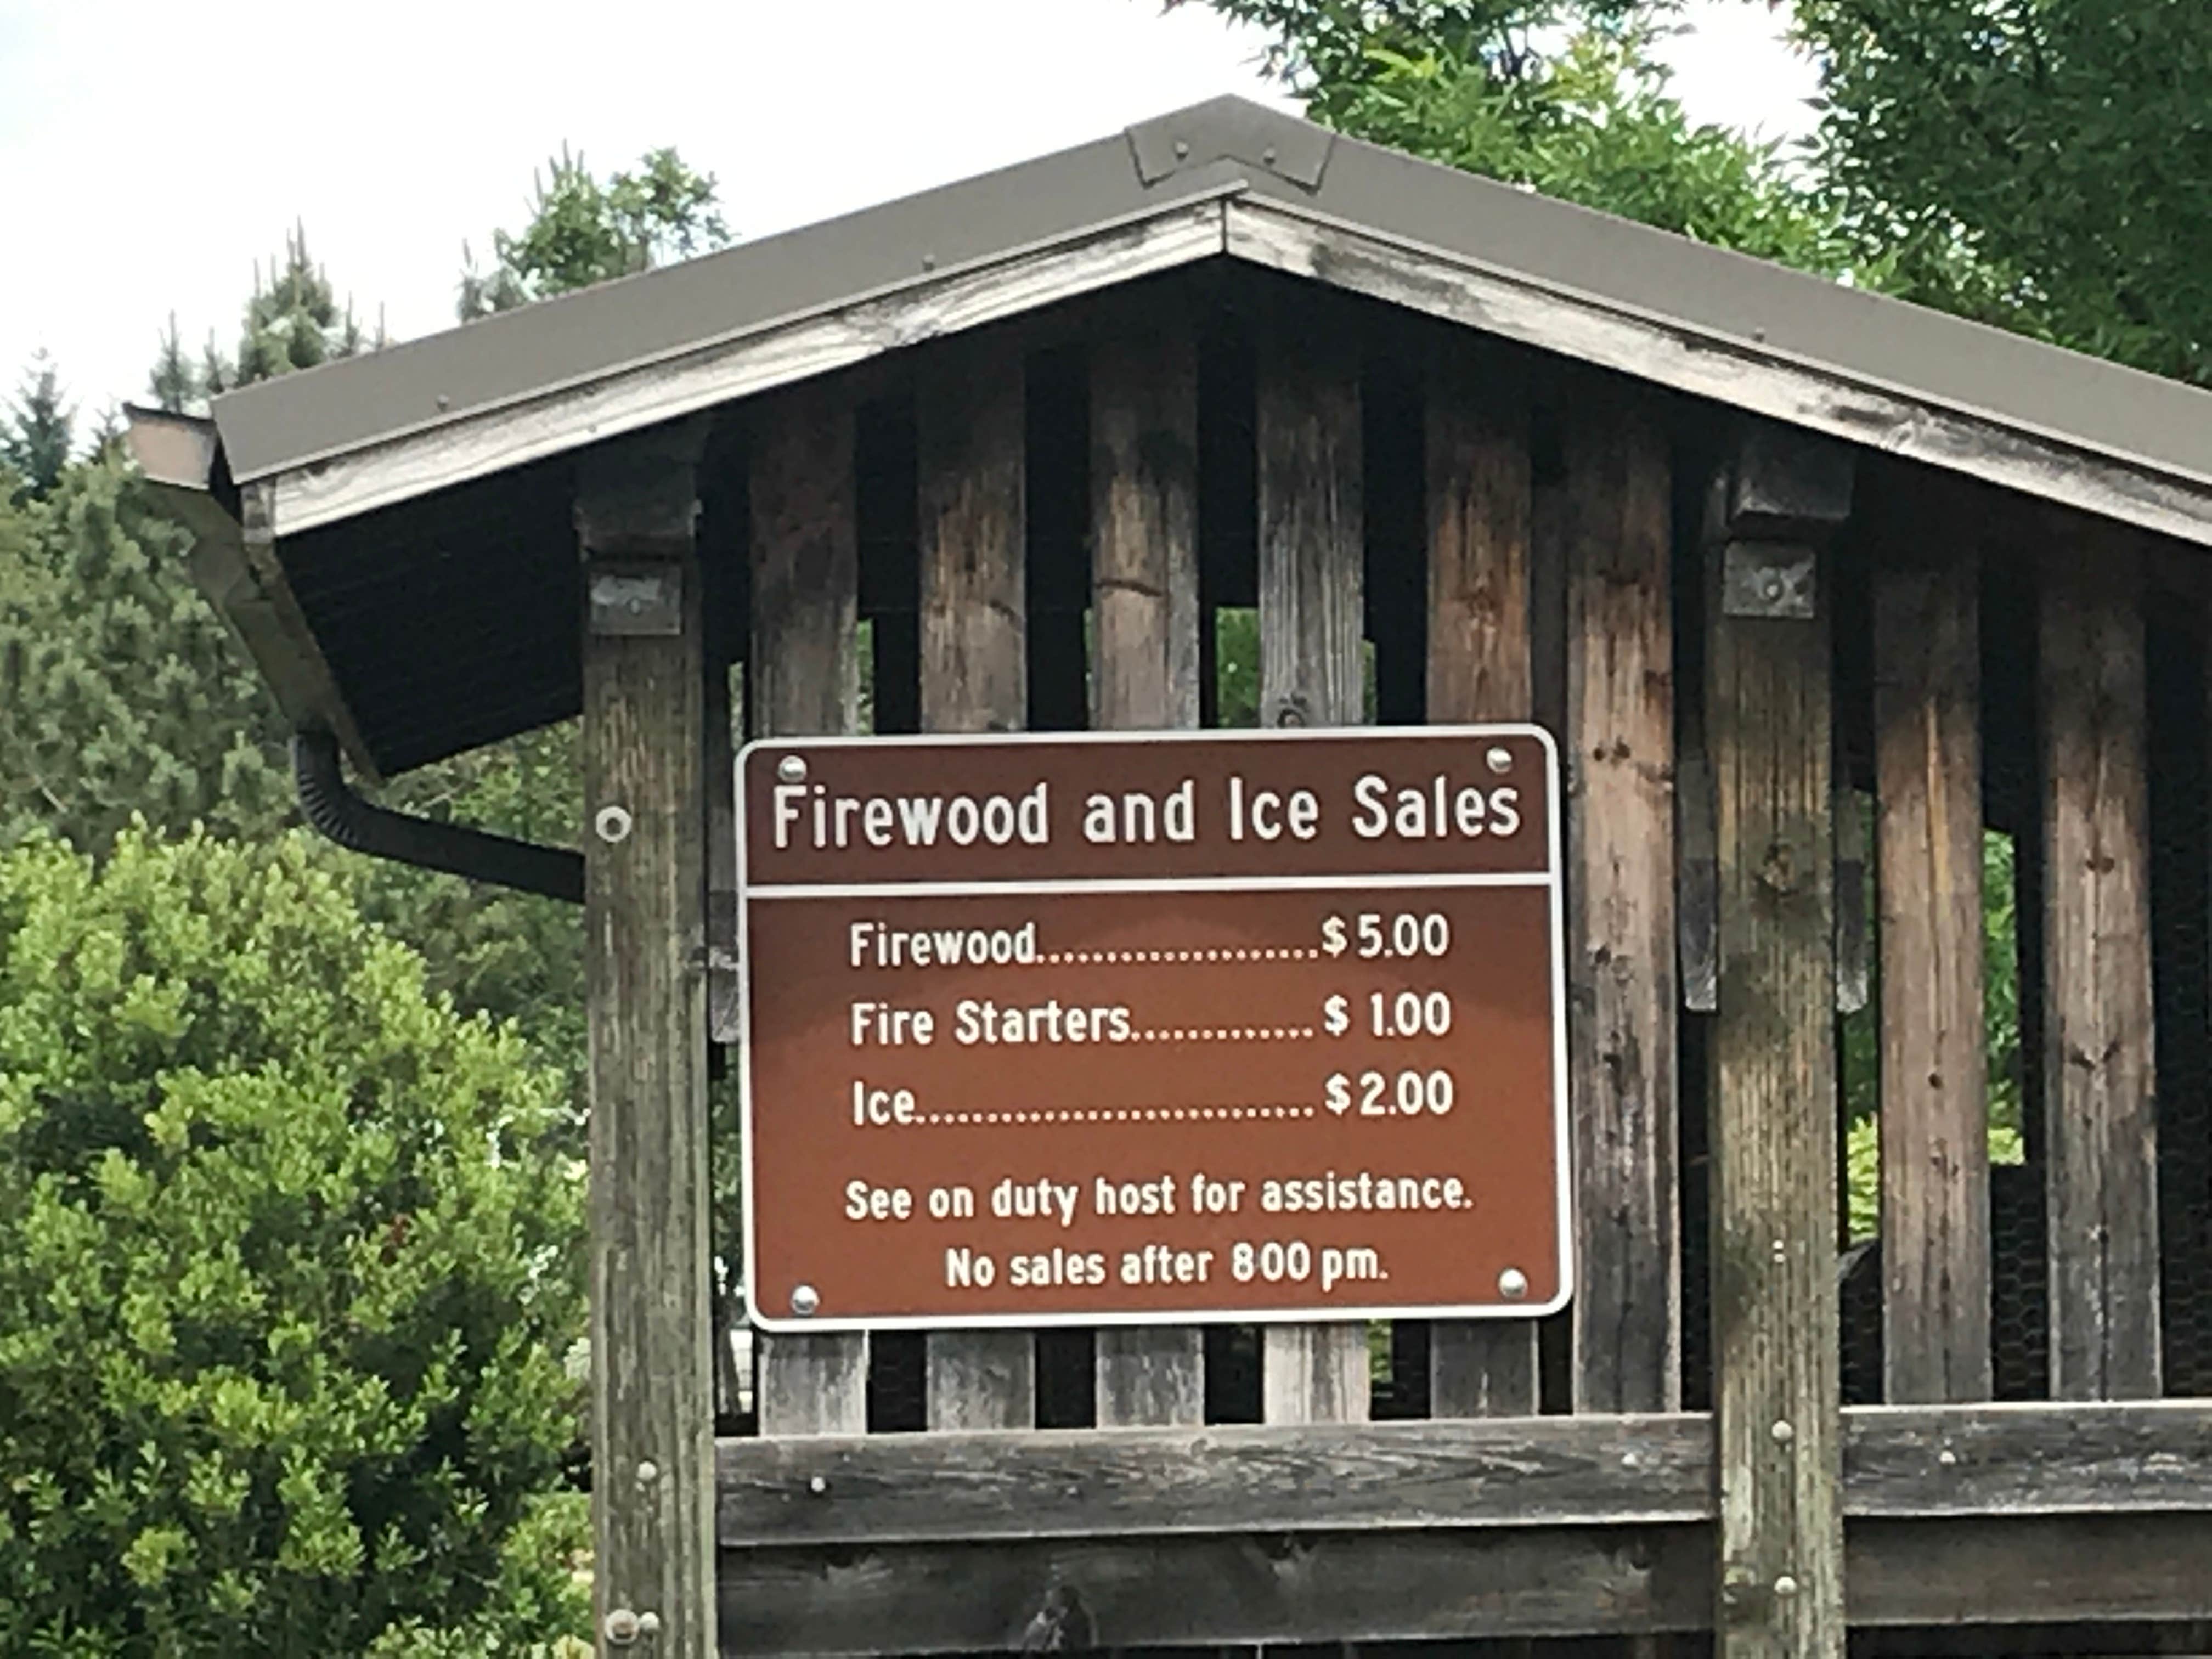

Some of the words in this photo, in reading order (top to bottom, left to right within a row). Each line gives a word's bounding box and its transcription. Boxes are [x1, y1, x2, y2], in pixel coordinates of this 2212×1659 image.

[774, 782, 1048, 848] Firewood
[1084, 780, 1195, 844] and
[1231, 777, 1318, 840] Ice
[1352, 775, 1520, 837] Sales
[852, 1002, 933, 1045] Fire
[845, 1180, 912, 1220] See
[929, 1188, 974, 1217] on
[991, 1178, 1079, 1227] duty
[1096, 1176, 1175, 1215] host
[1190, 1172, 1246, 1213] for
[1261, 1171, 1473, 1211] assistance.
[946, 1248, 995, 1287] No
[1009, 1248, 1106, 1286] sales
[1120, 1244, 1214, 1284] after
